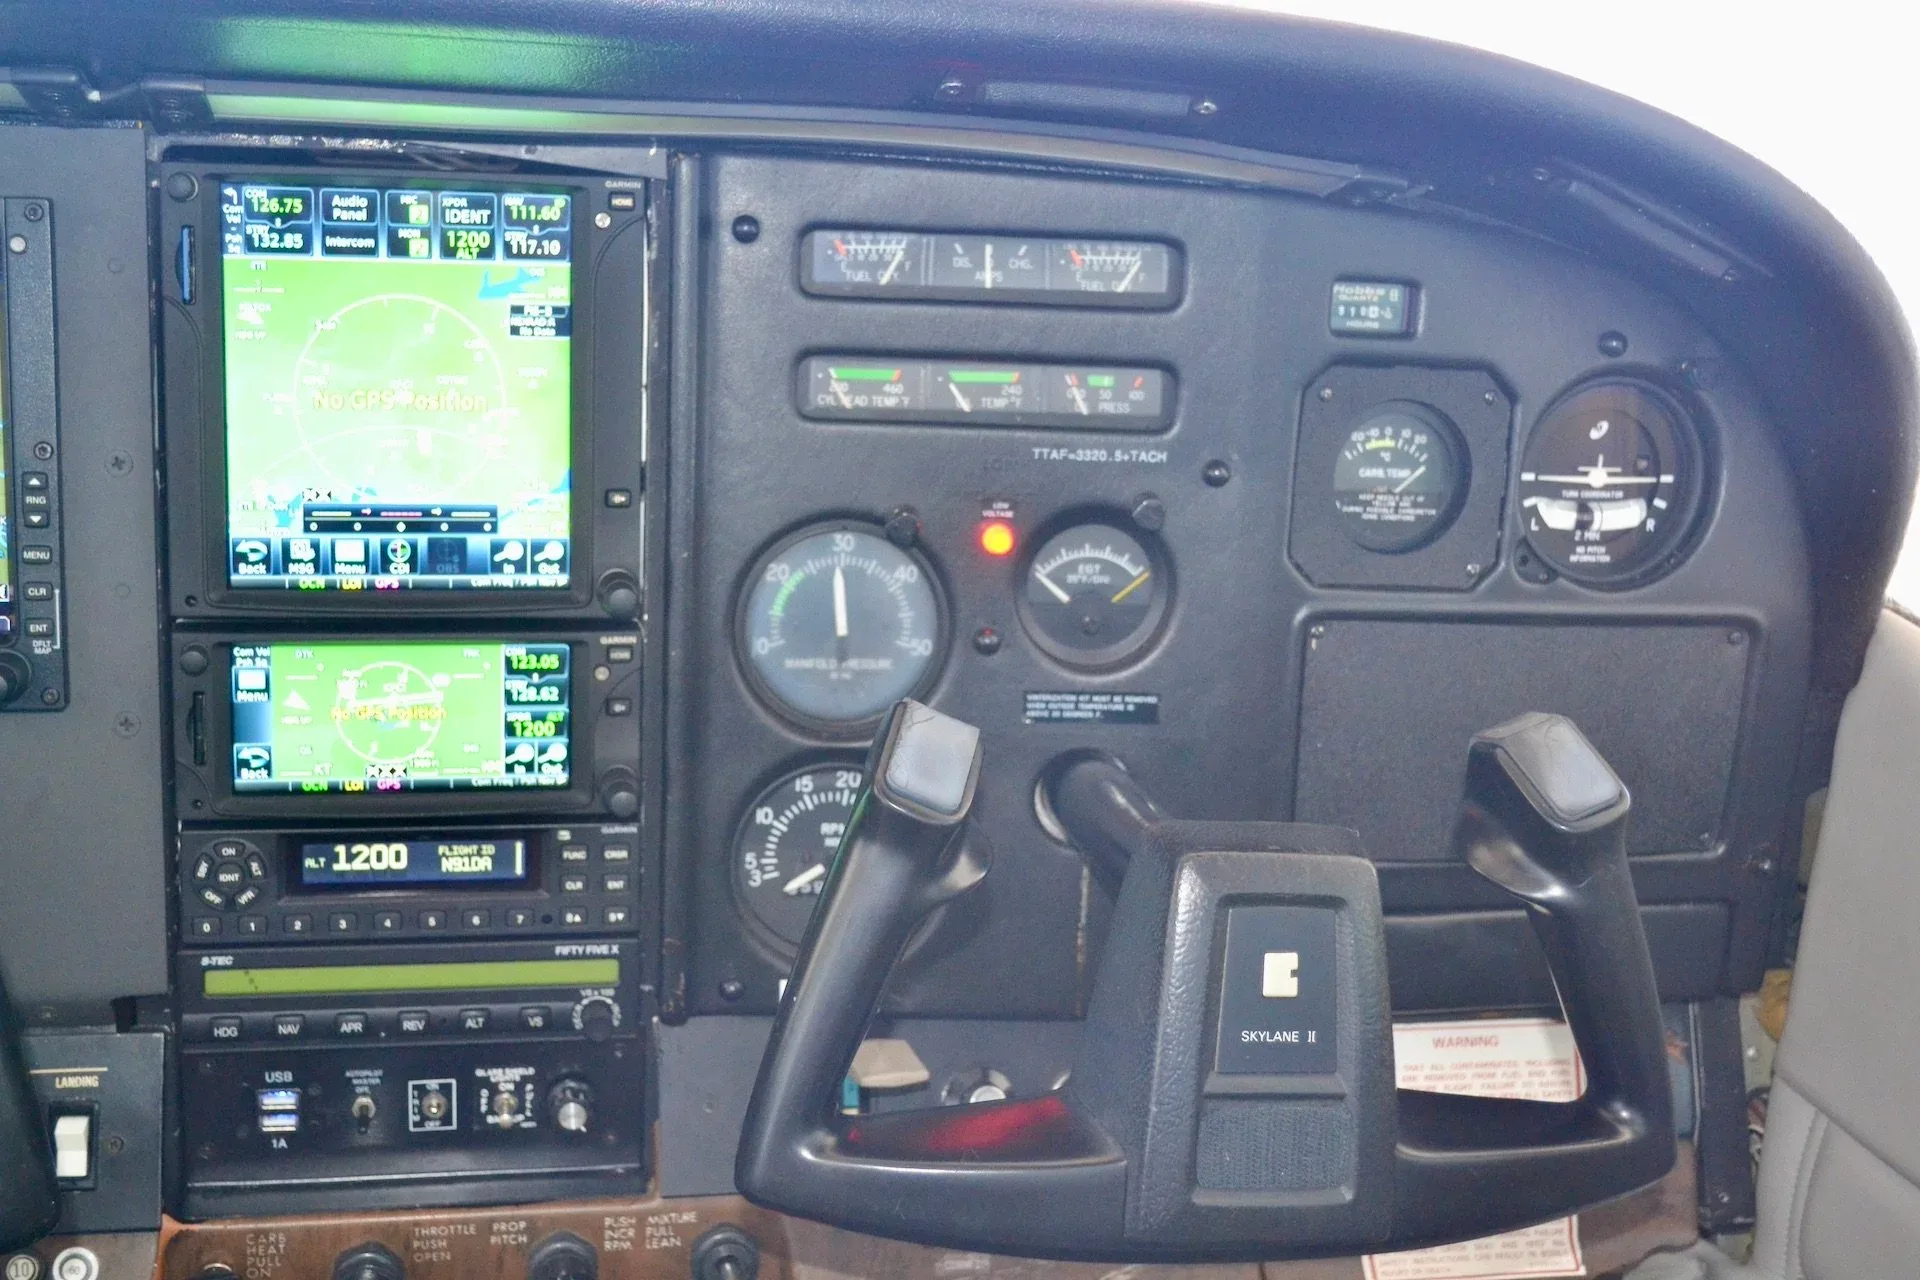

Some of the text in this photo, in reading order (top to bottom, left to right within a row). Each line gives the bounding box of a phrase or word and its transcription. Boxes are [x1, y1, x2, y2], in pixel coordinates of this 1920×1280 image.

[252, 197, 303, 213] 126.75
[332, 195, 368, 208] Audio
[333, 208, 367, 221] Panel
[445, 209, 491, 224] IDENT
[510, 205, 560, 220] 111.60
[252, 233, 303, 249] 132.85
[325, 235, 375, 248] Intercom
[447, 231, 491, 248] 1200
[456, 247, 480, 260] ALT
[510, 240, 560, 255] 117.10
[845, 271, 872, 283] FUEL
[882, 383, 905, 395] 460
[1001, 384, 1023, 396] 240
[313, 388, 344, 411] No
[351, 388, 397, 411] GPS
[872, 396, 900, 408] TEMP
[981, 397, 1009, 409] TEMP
[1098, 401, 1131, 413] PRESS
[1032, 447, 1167, 463] TTAF=3320.5+TACH
[25, 496, 47, 504] RNG
[981, 510, 1014, 518] VOLTAGE
[1530, 517, 1540, 531] L
[1646, 517, 1656, 533] R
[1574, 530, 1581, 542] 2
[833, 533, 855, 552] 30
[23, 550, 50, 559] MENU
[238, 563, 267, 575] Back
[766, 563, 790, 581] 20
[893, 564, 919, 584] 40
[1078, 563, 1101, 575] EGT
[28, 587, 47, 596] CLR
[30, 624, 48, 632] ENT
[34, 647, 52, 655] MAP
[756, 636, 769, 655] 0
[511, 654, 559, 670] 123.05
[236, 690, 268, 702] Menu
[513, 721, 556, 737] 1200
[241, 767, 269, 780] Back
[835, 770, 862, 788] 20
[377, 780, 401, 791] GPS
[795, 774, 814, 792] 15
[755, 806, 774, 825] 10
[222, 847, 236, 856] ON
[332, 843, 408, 871] 1200
[438, 845, 476, 857] FLIGHT
[563, 851, 587, 860] FUNC
[304, 857, 326, 868] ALT
[744, 851, 758, 871] 5
[219, 873, 239, 882] IDNT
[747, 869, 762, 888] 3
[565, 881, 583, 890] CLR
[607, 881, 624, 890] ENT
[238, 891, 256, 905] VFR
[611, 944, 619, 955] X
[200, 955, 234, 966] S-TEC
[340, 1022, 363, 1033] APR
[402, 1020, 425, 1032] REV
[465, 1017, 486, 1029] ALT
[527, 1016, 544, 1027] VS
[213, 1027, 238, 1038] HDG
[277, 1024, 300, 1035] NAV
[1241, 1030, 1299, 1042] SKYLANE
[1432, 1035, 1499, 1049] WARNING
[55, 1076, 99, 1088] LANDING
[265, 1071, 293, 1083] USB
[271, 1138, 288, 1149] 1A
[604, 1216, 636, 1228] PUSH
[647, 1211, 698, 1225] MIXTURE
[413, 1224, 477, 1237] THROTTLE
[492, 1221, 527, 1233] PROP
[246, 1232, 287, 1245] CARB
[413, 1239, 448, 1249] PUSH
[490, 1234, 528, 1246] PITCH
[646, 1236, 682, 1249] LEAN
[246, 1244, 286, 1255] HEAT
[246, 1255, 282, 1268] PULL
[413, 1251, 451, 1263] OPEN
[13, 1262, 30, 1278] 10
[246, 1268, 272, 1279] ON
